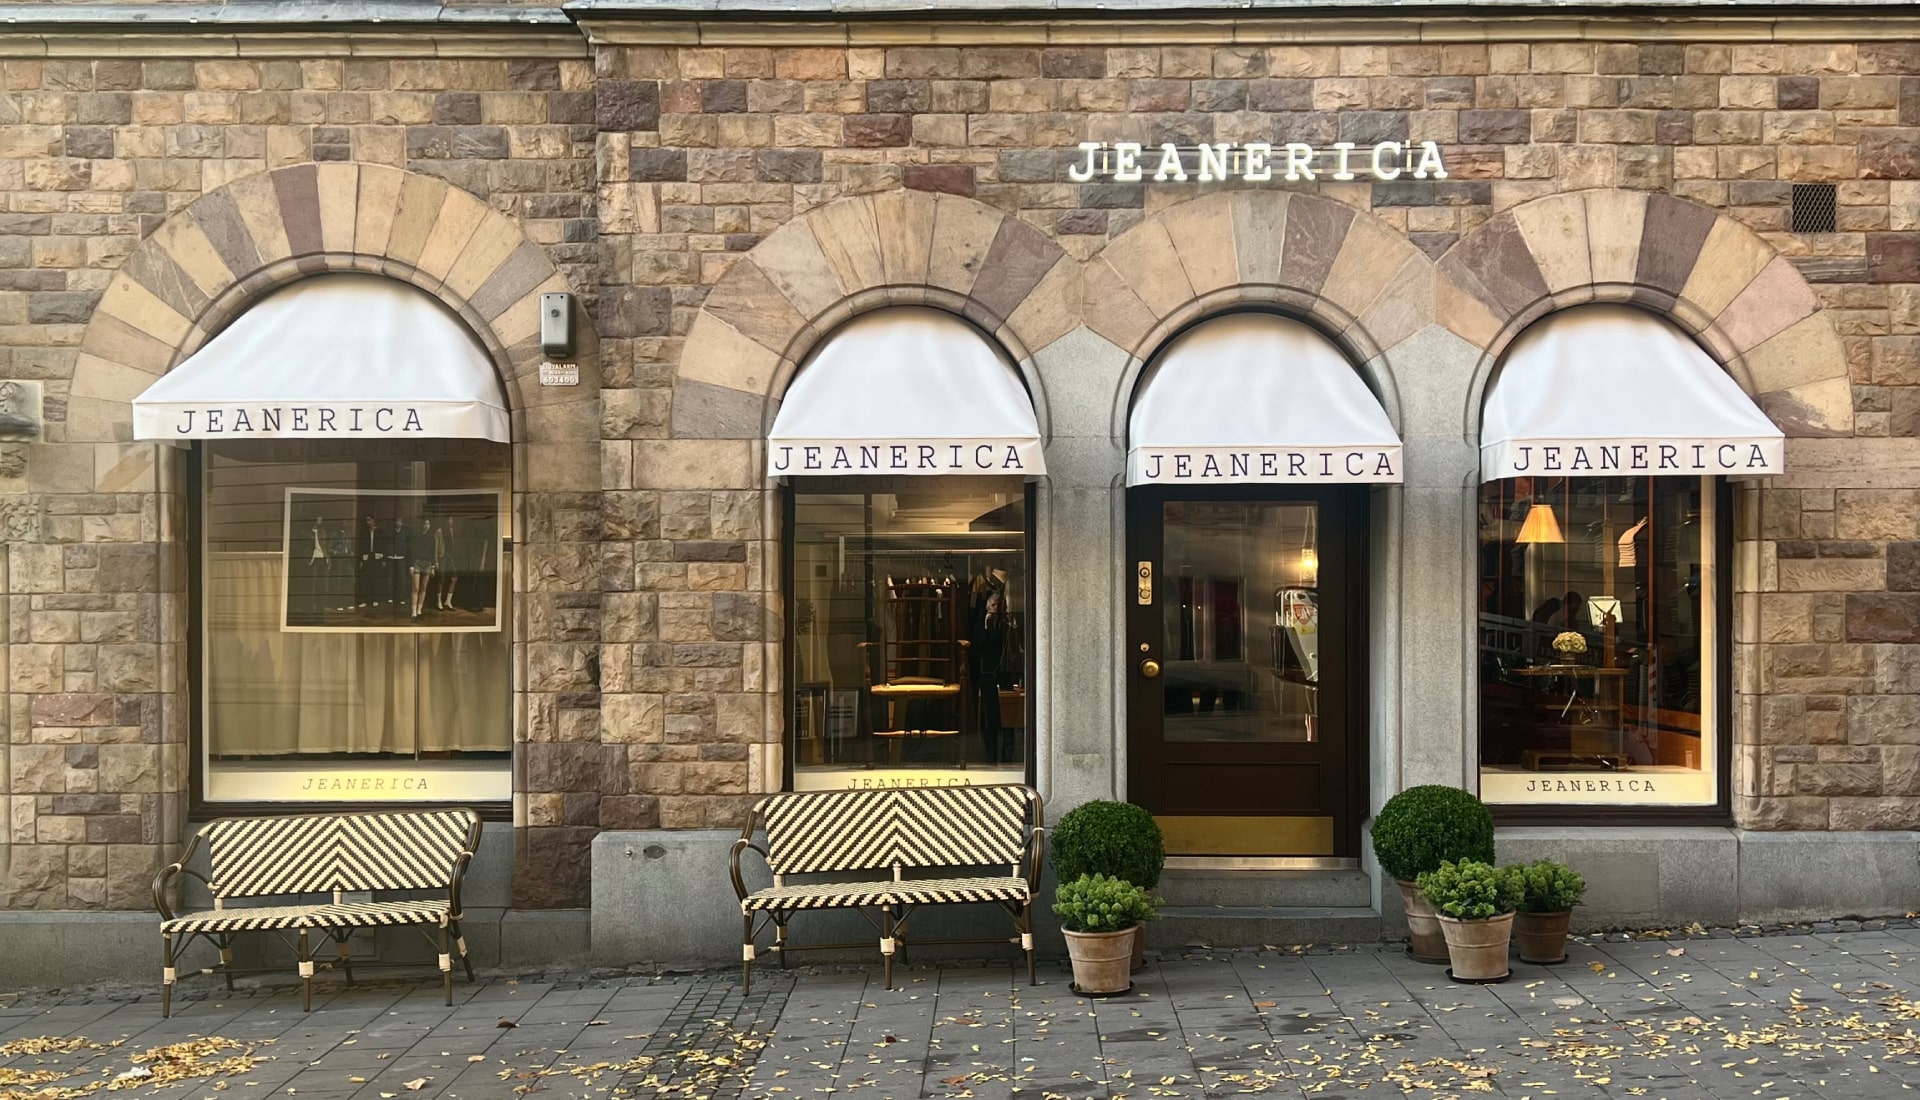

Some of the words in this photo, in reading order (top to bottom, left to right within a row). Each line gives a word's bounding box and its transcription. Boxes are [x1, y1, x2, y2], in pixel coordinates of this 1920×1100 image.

[1069, 140, 1448, 181] JEANERICA
[176, 408, 424, 433] JEANERICA
[776, 445, 1024, 470] JEANERICA
[1146, 453, 1395, 478] JEANERICA
[1514, 445, 1769, 470] JEANERICA
[302, 778, 428, 790] JEANERICA
[1527, 780, 1656, 792] JEANERICA
